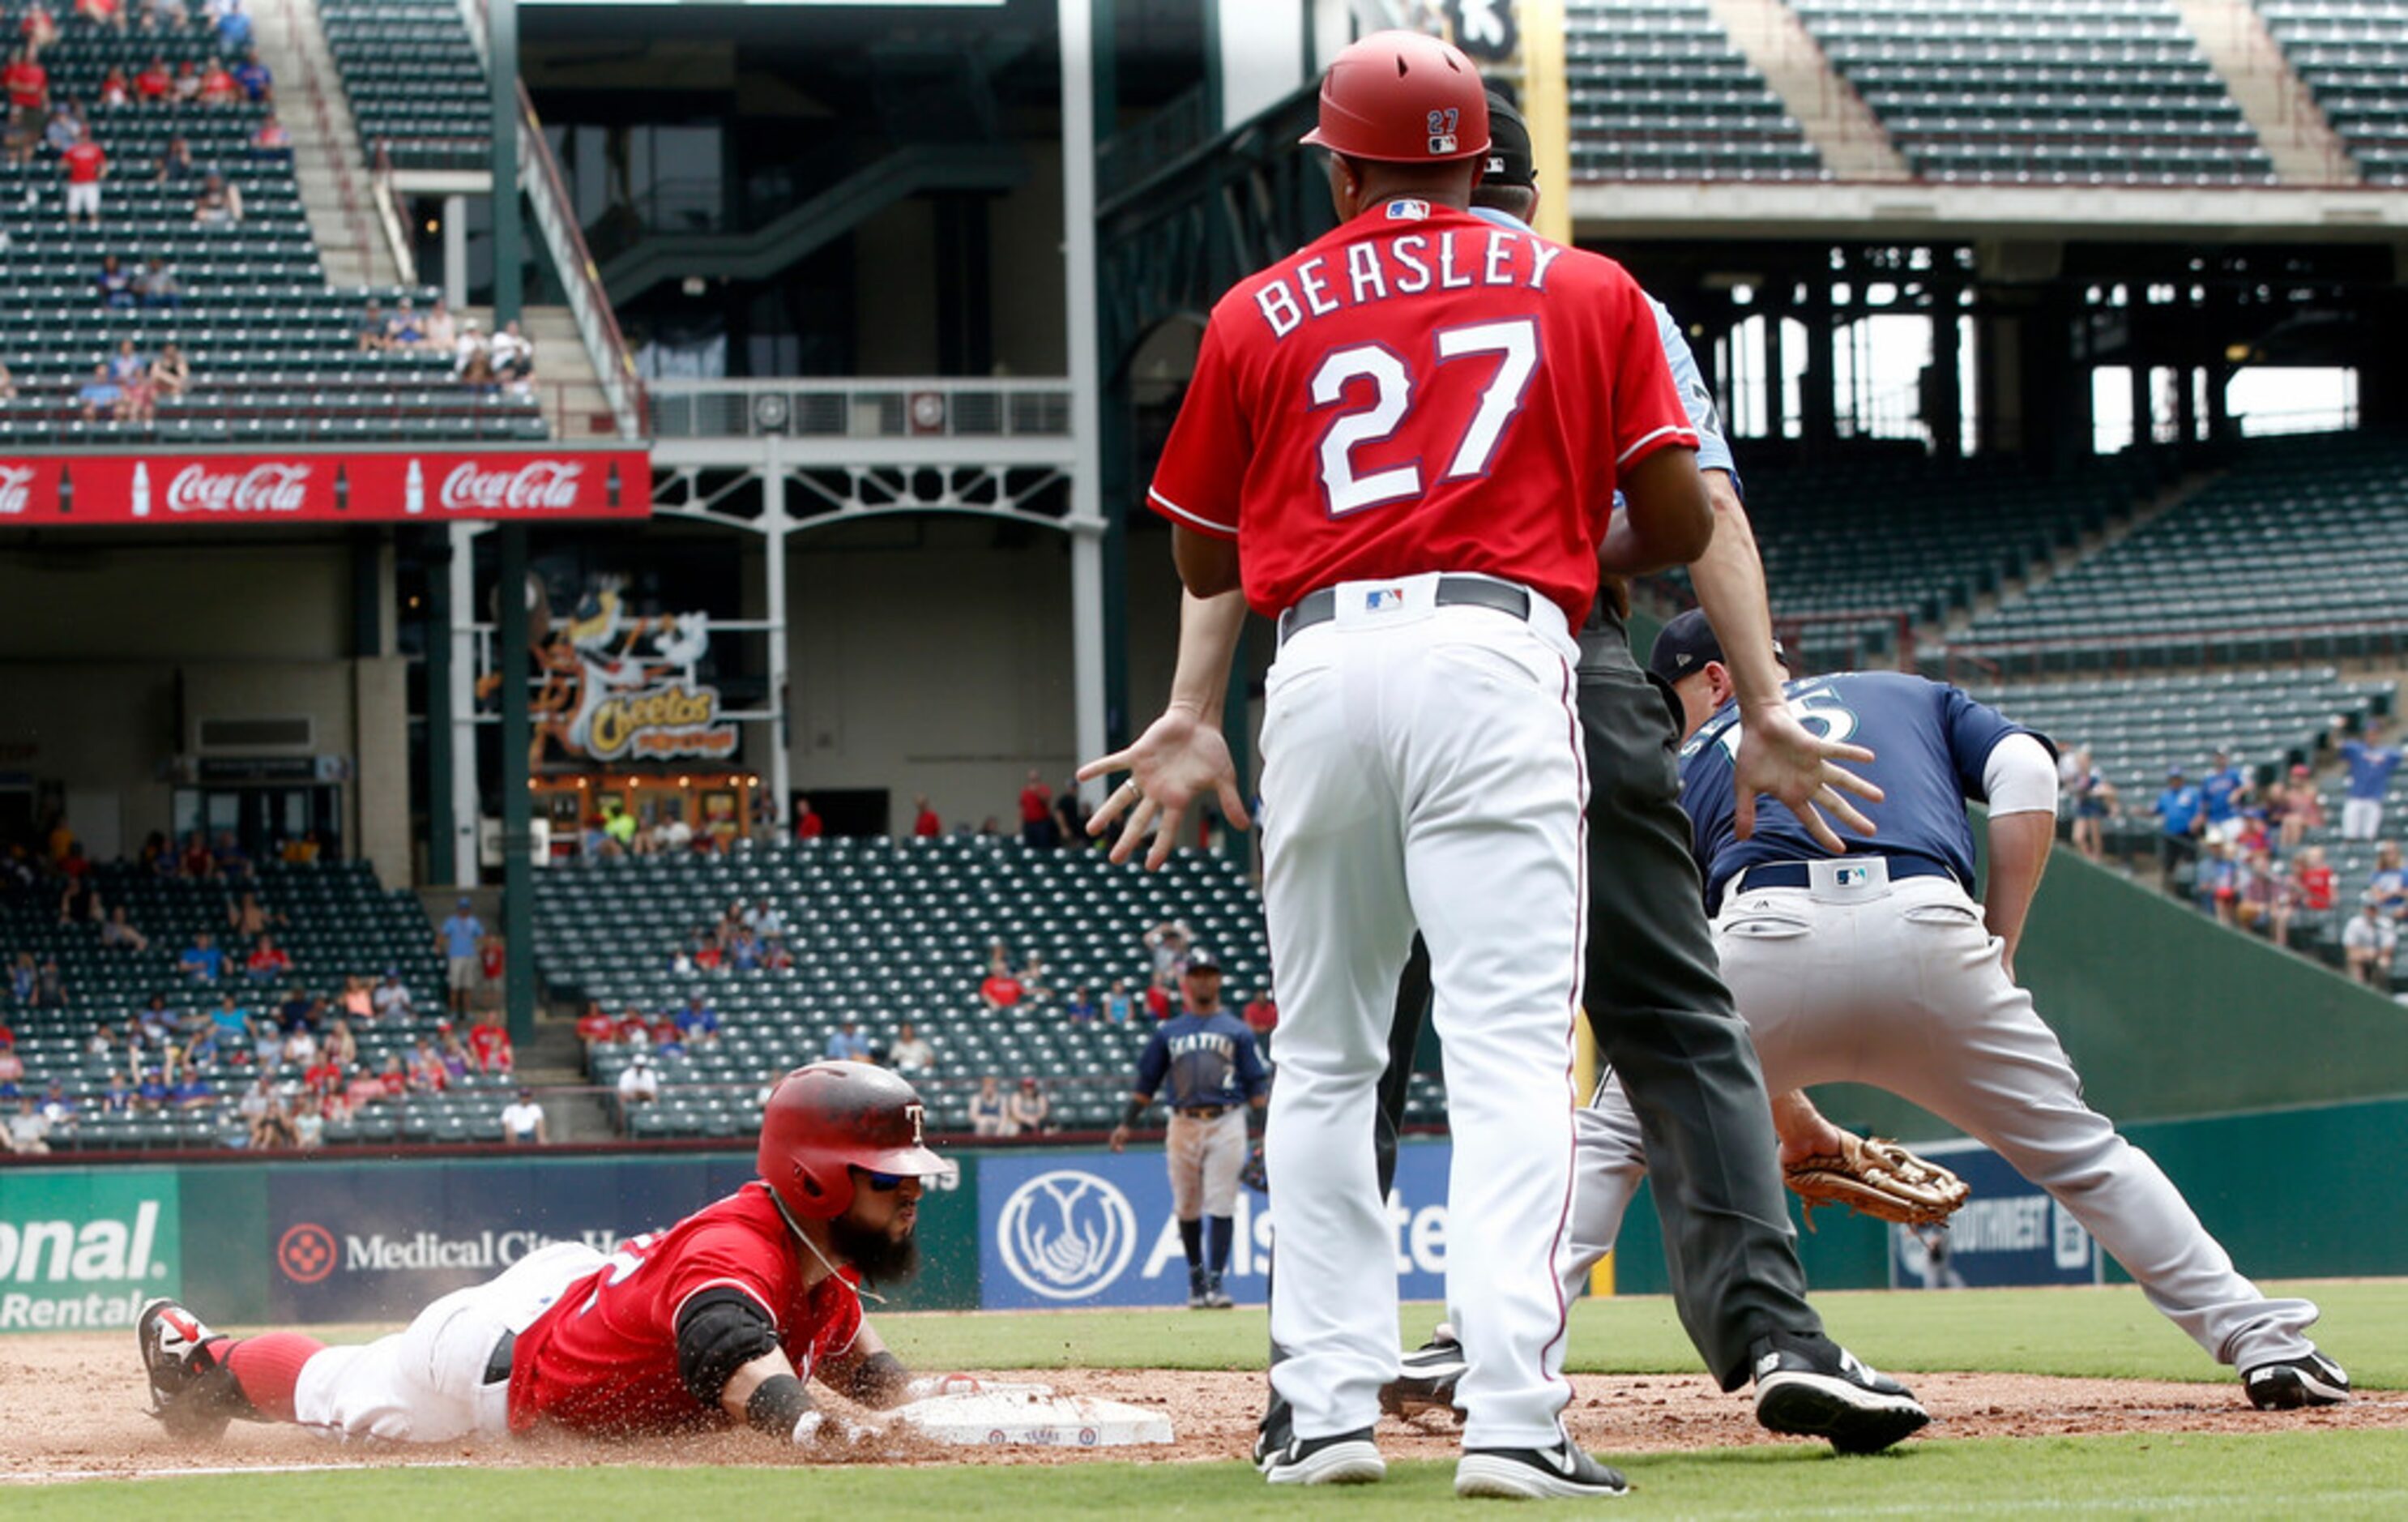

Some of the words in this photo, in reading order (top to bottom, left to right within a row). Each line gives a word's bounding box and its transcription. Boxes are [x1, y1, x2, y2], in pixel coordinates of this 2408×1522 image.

[1427, 107, 1458, 135] 27
[1254, 230, 1561, 339] BEASLEY
[1307, 315, 1541, 520] 27
[591, 684, 713, 754] Cheetos
[905, 1105, 924, 1144] T
[345, 1229, 493, 1271] Medical
[0, 1289, 143, 1328] Rental
